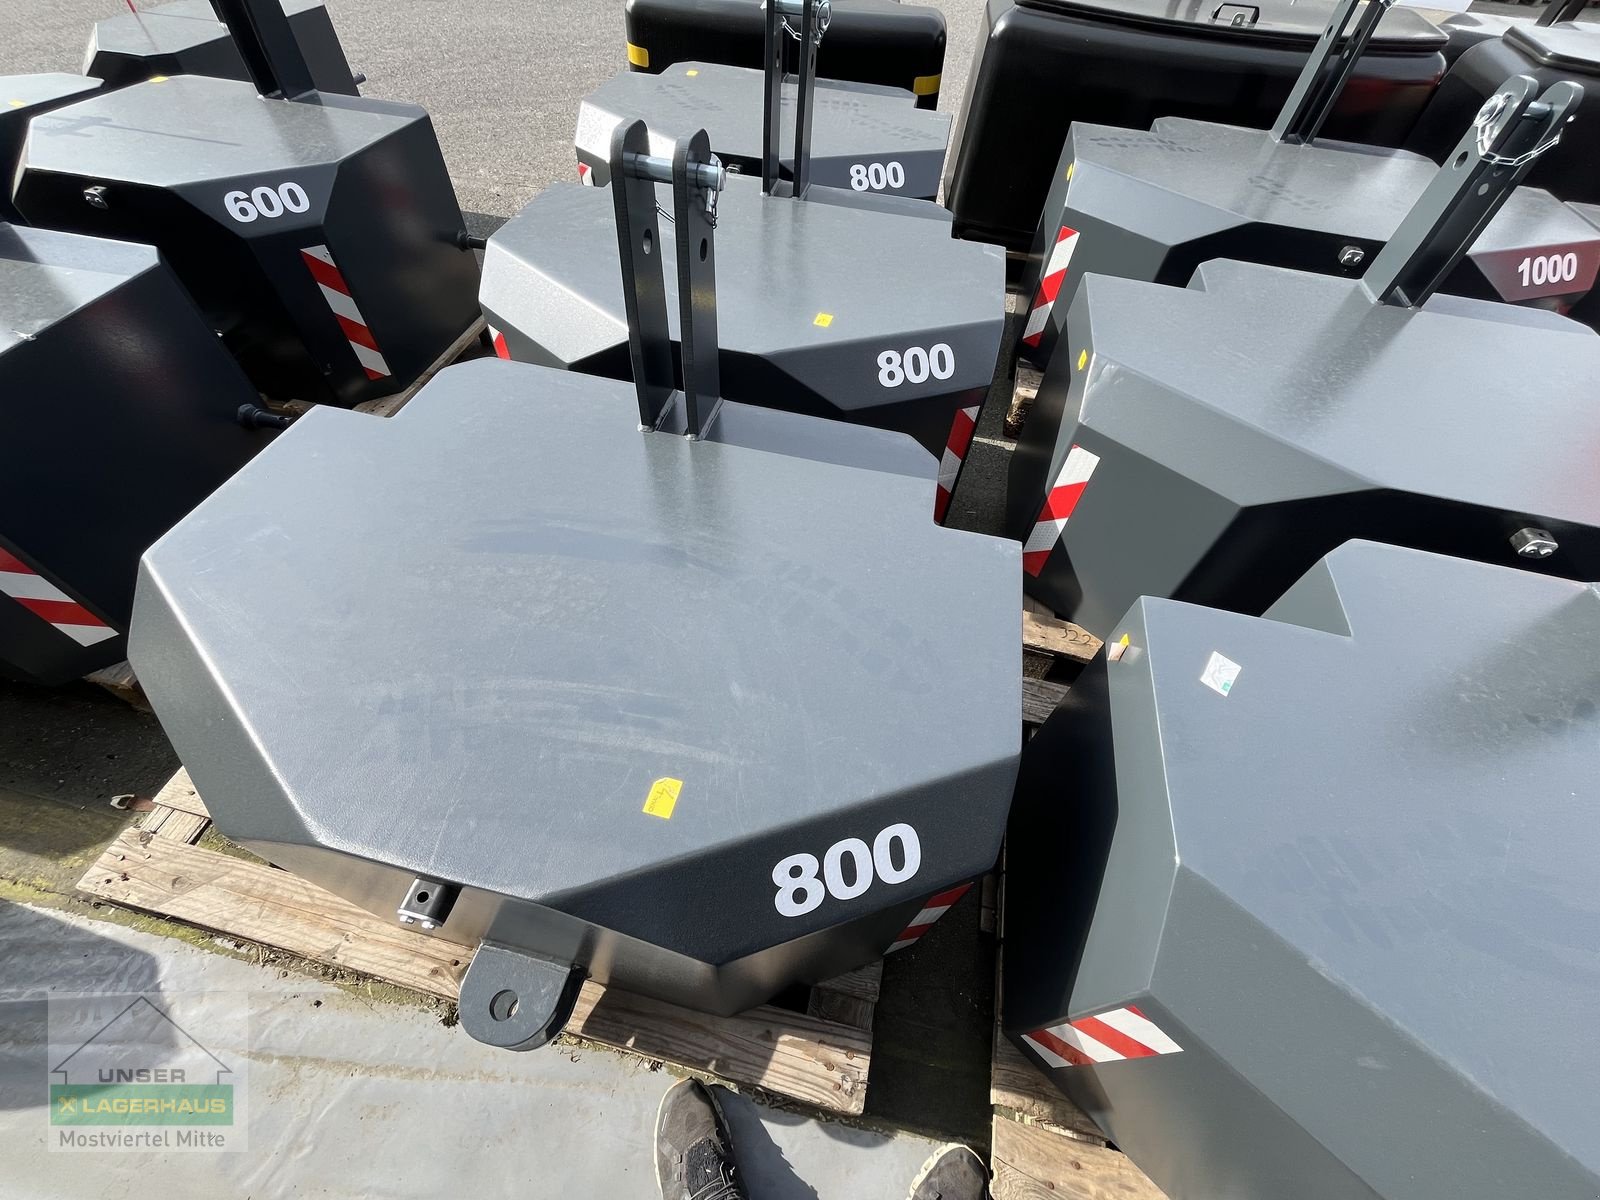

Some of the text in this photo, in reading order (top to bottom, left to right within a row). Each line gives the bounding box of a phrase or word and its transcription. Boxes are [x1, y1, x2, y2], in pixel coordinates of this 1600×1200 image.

[849, 161, 905, 192] 800
[224, 182, 310, 223] 600
[1517, 252, 1578, 287] 1000
[876, 343, 955, 388] 800
[771, 823, 922, 918] 800
